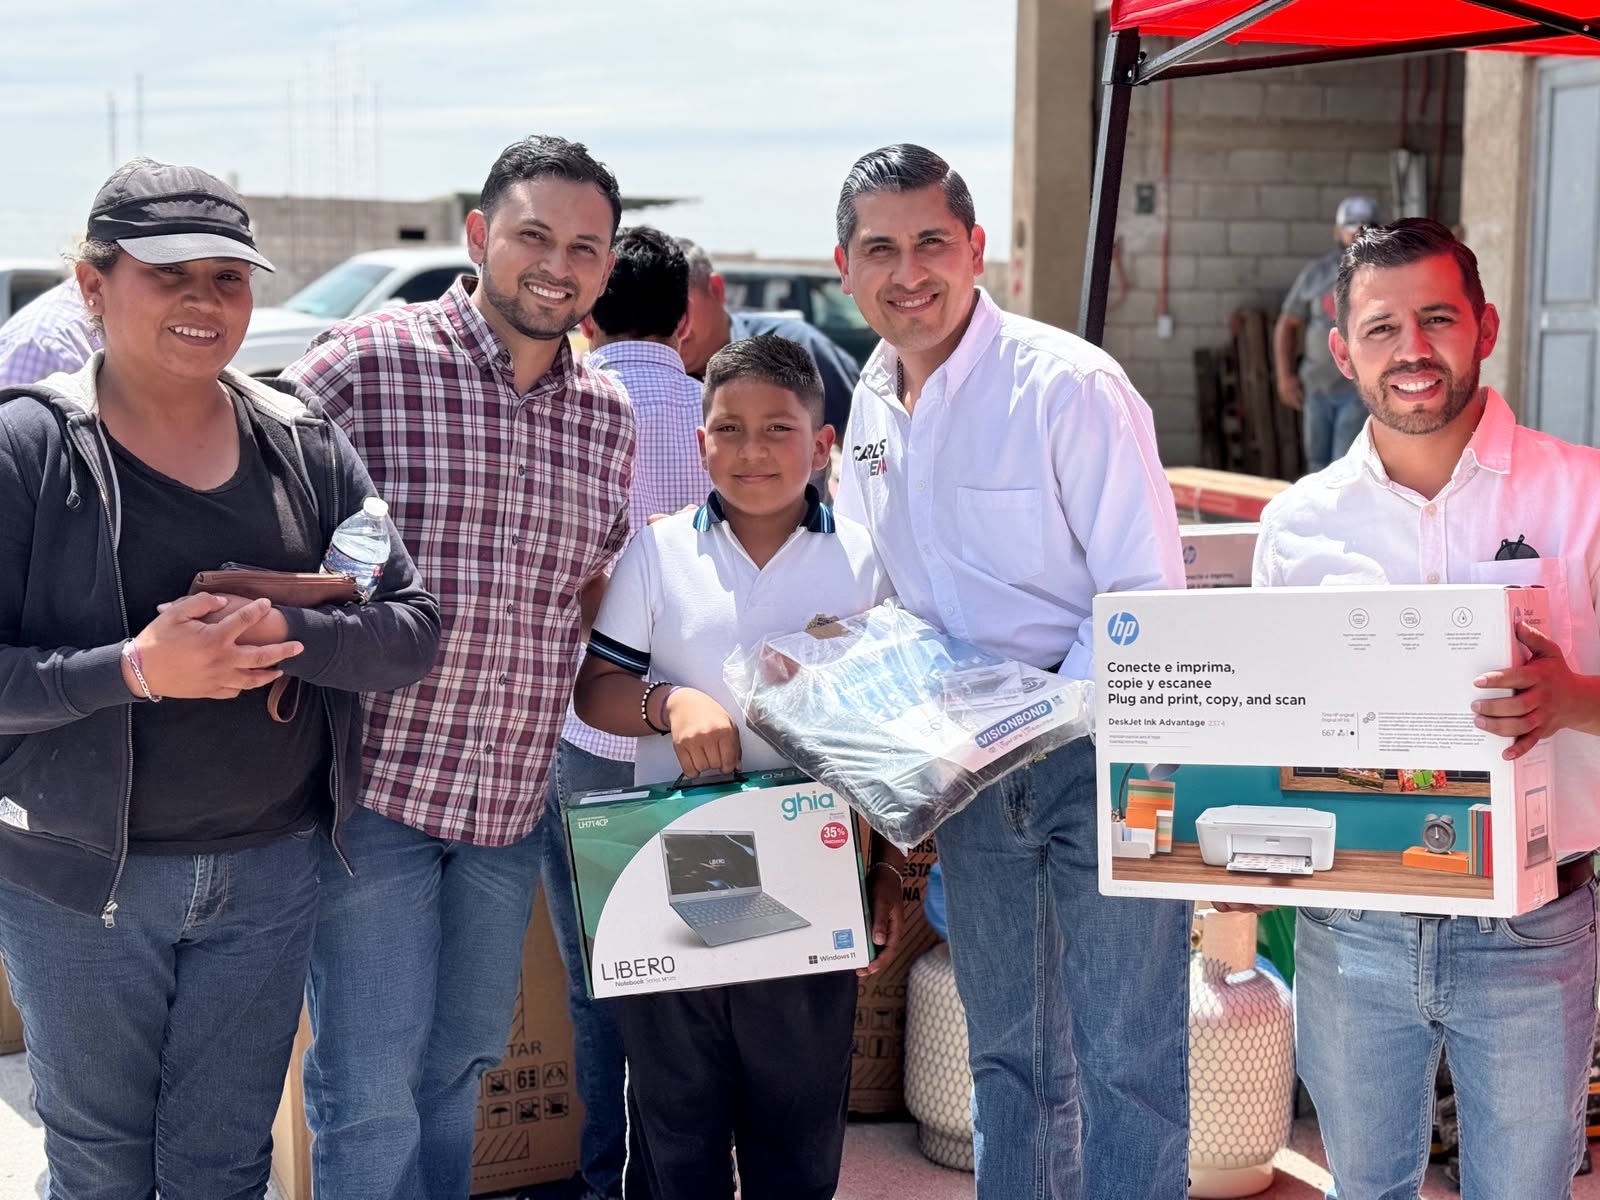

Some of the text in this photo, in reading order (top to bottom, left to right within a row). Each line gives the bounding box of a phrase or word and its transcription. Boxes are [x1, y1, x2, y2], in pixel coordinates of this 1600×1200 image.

[1108, 611, 1139, 646] hp
[1107, 661, 1235, 675] Conecte e imprima,
[1107, 677, 1212, 690] copie y escanee
[1108, 693, 1306, 707] Plug and print, copy, and scan
[976, 702, 1049, 746] VISIONBOND
[1108, 718, 1141, 726] DeskJet
[1144, 718, 1157, 726] Ink
[1159, 718, 1206, 728] Advantage
[1321, 729, 1335, 737] 667
[781, 790, 835, 821] ghia
[823, 826, 846, 838] 35%
[903, 886, 921, 902] NA
[819, 953, 850, 962] Windows
[601, 955, 676, 981] LIBERO
[615, 978, 645, 987] Notebook
[506, 1039, 542, 1059] TAR
